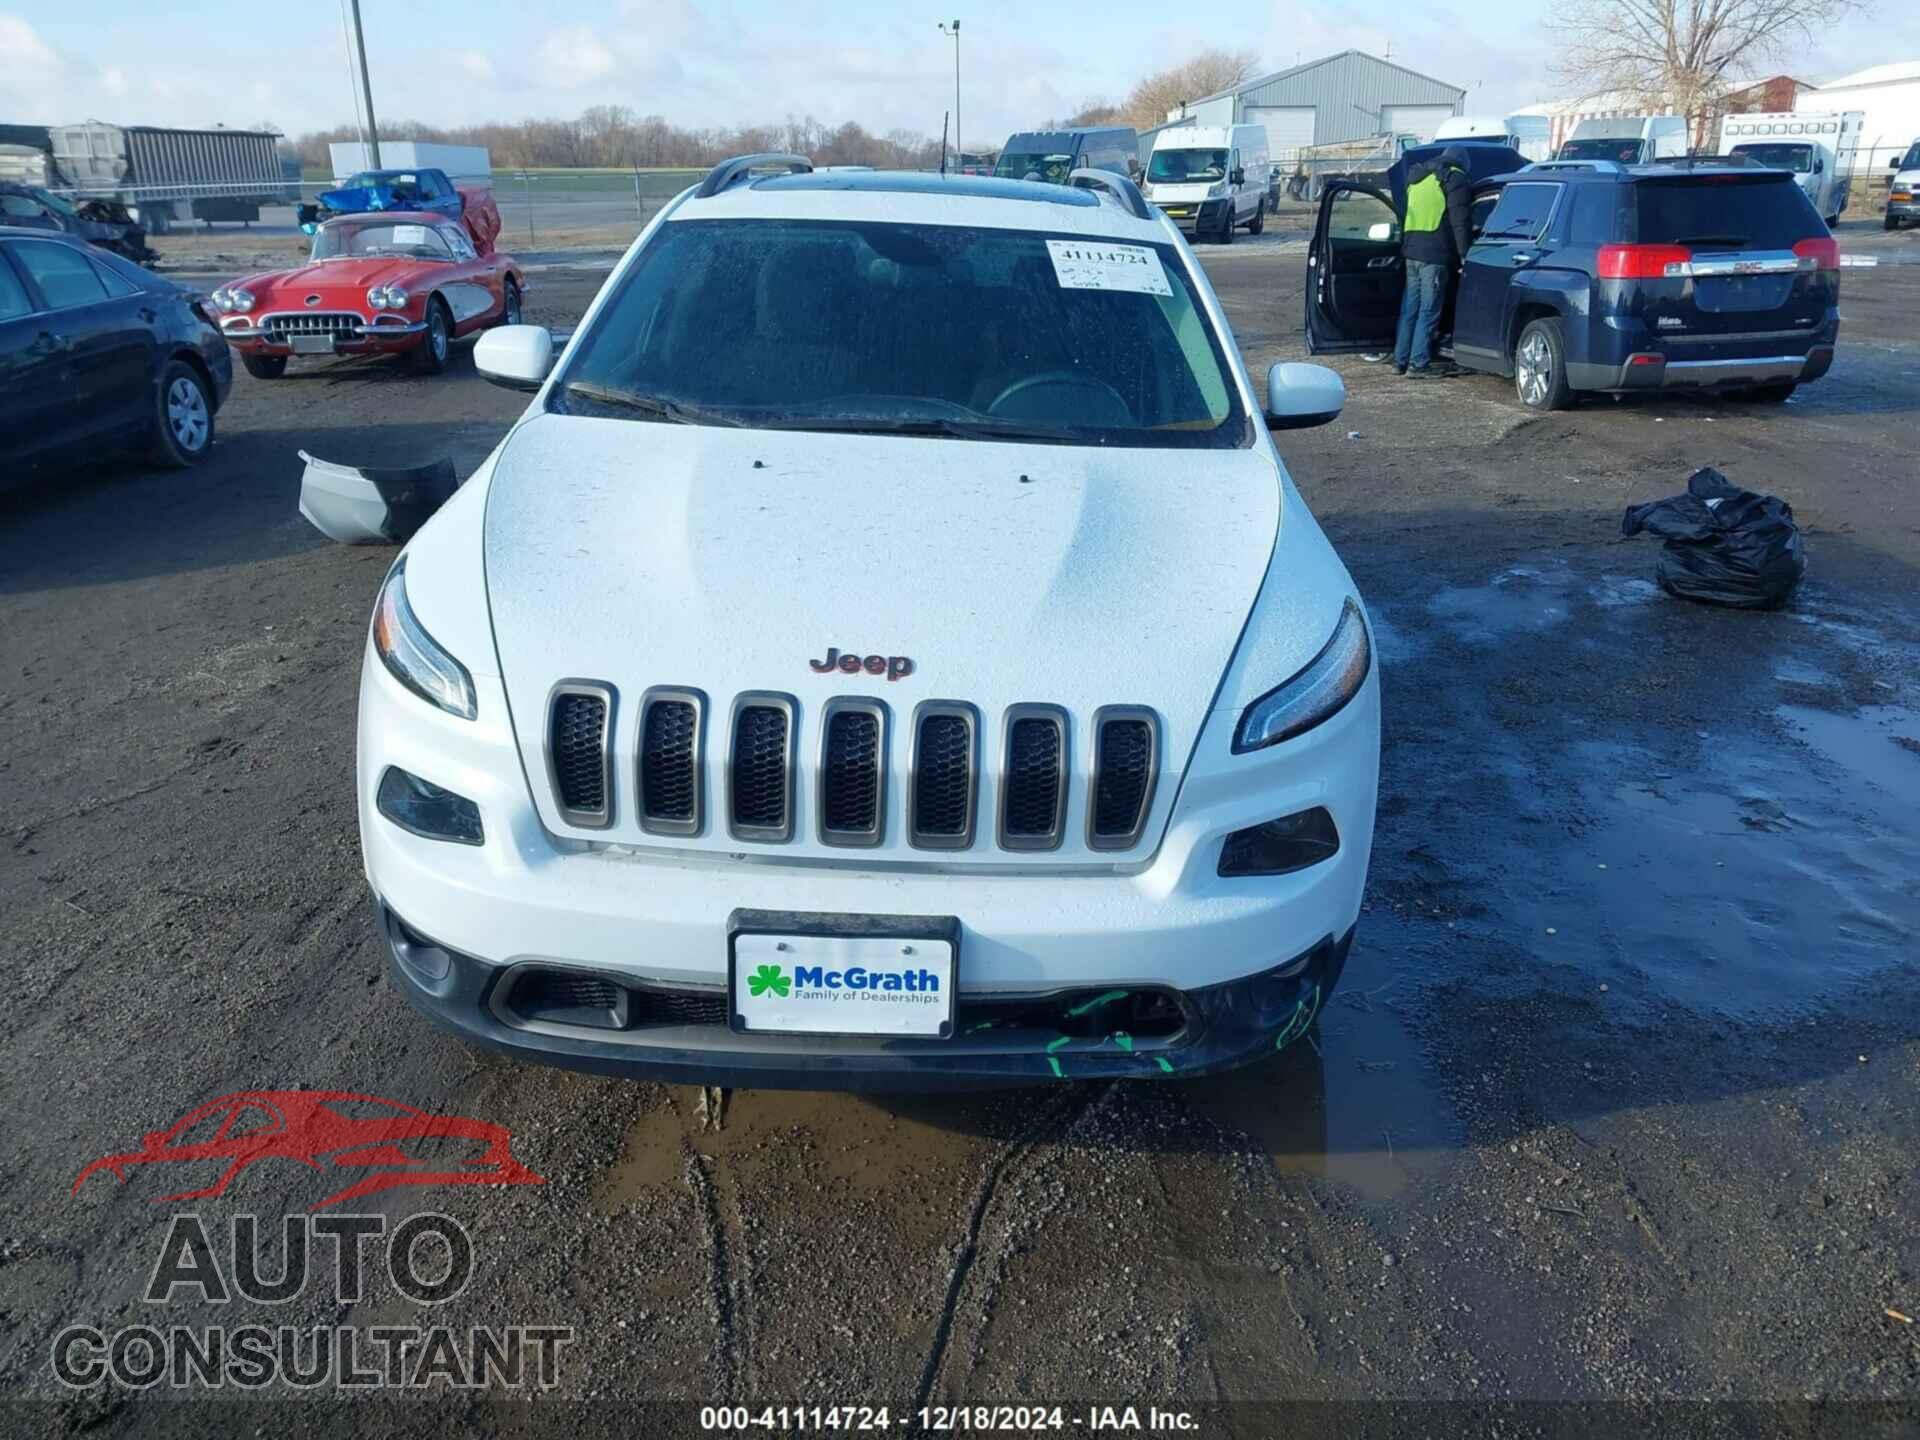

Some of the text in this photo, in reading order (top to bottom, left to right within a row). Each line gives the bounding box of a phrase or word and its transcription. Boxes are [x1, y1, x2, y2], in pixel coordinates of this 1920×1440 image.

[1061, 250, 1148, 265] 41114724
[809, 647, 914, 682] Jeep
[794, 965, 940, 992] McGrath
[795, 990, 939, 1004] Family of Dealerships
